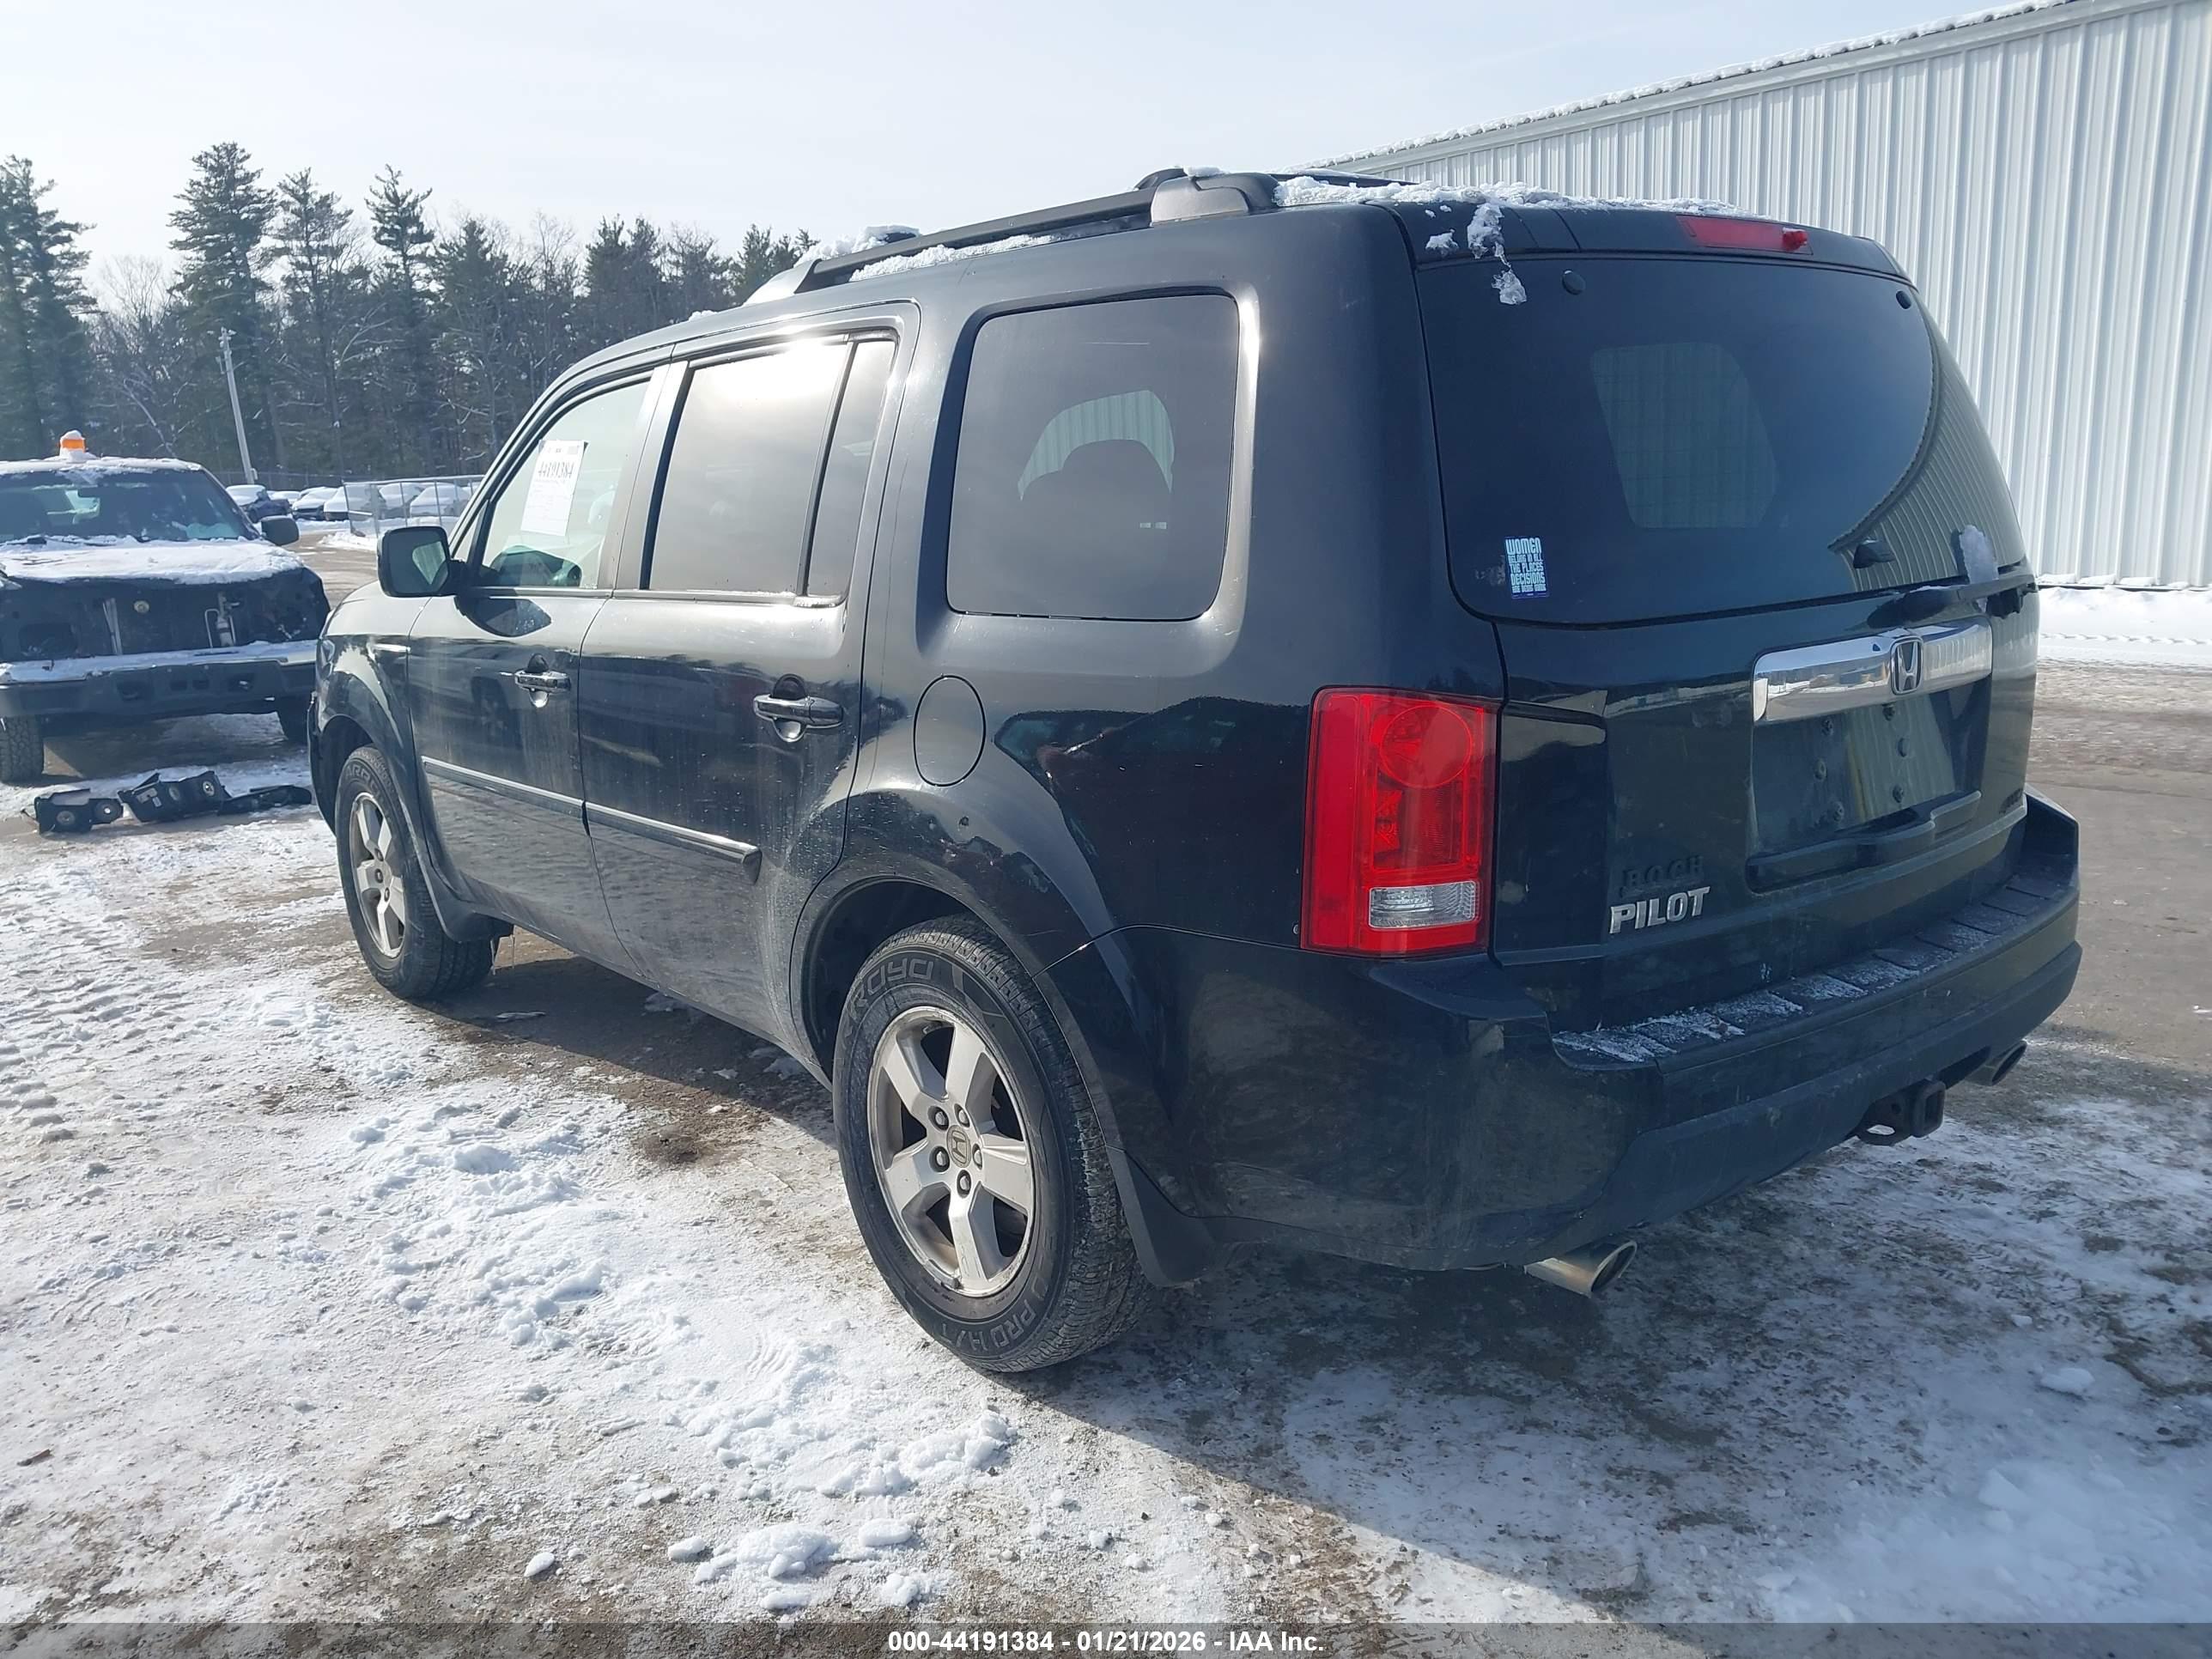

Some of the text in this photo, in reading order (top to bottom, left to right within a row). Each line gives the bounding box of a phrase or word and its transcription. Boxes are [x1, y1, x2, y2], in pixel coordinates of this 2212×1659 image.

[538, 461, 575, 479] 44191384
[1505, 537, 1542, 555] WOMEN
[1510, 562, 1544, 573] THE PLACES
[1510, 571, 1546, 586] DECISIONS
[1609, 886, 1711, 934] PILOT
[990, 1297, 1036, 1349] PRO
